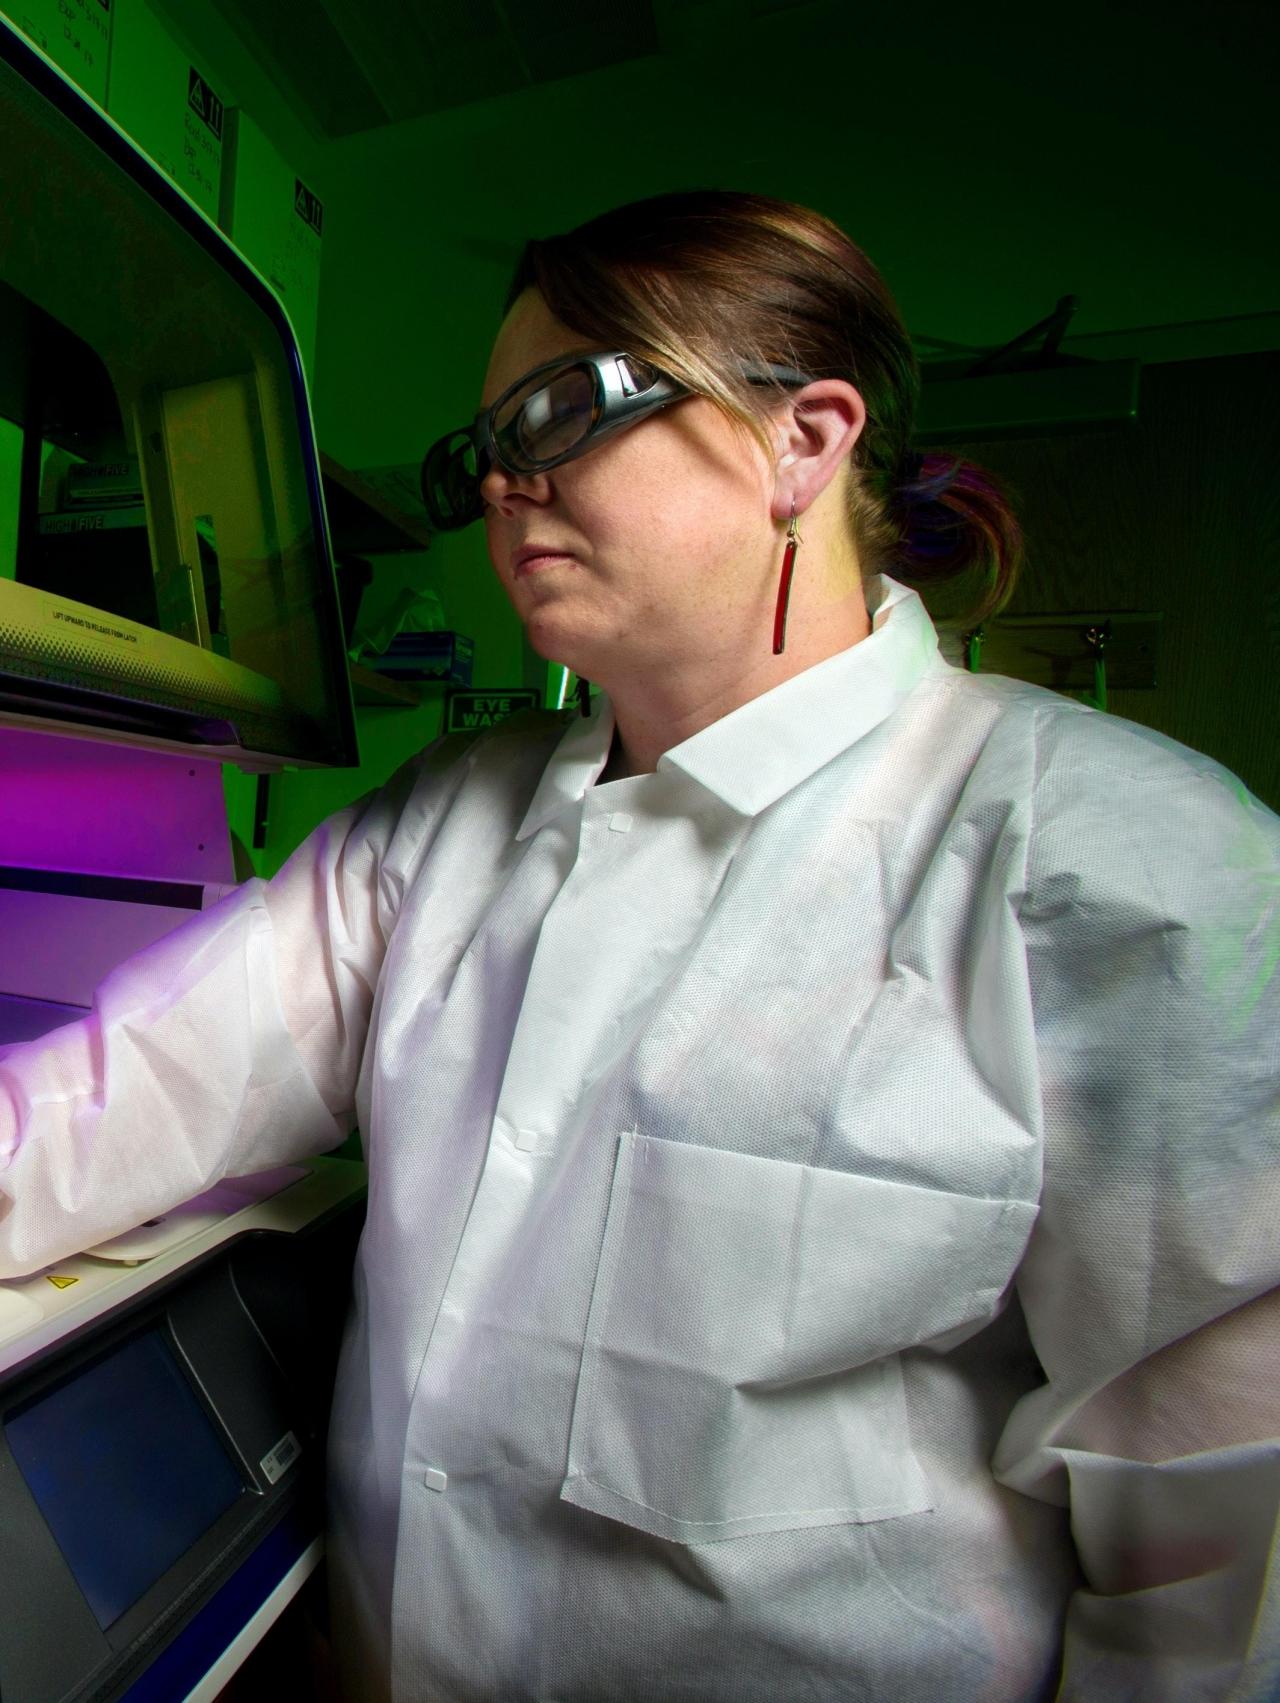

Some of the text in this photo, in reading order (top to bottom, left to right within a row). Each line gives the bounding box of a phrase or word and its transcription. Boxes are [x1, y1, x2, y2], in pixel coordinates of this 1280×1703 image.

[78, 514, 104, 530] FIVE
[52, 611, 64, 619] LIFT
[473, 698, 511, 712] EYE
[463, 713, 511, 727] WAS
